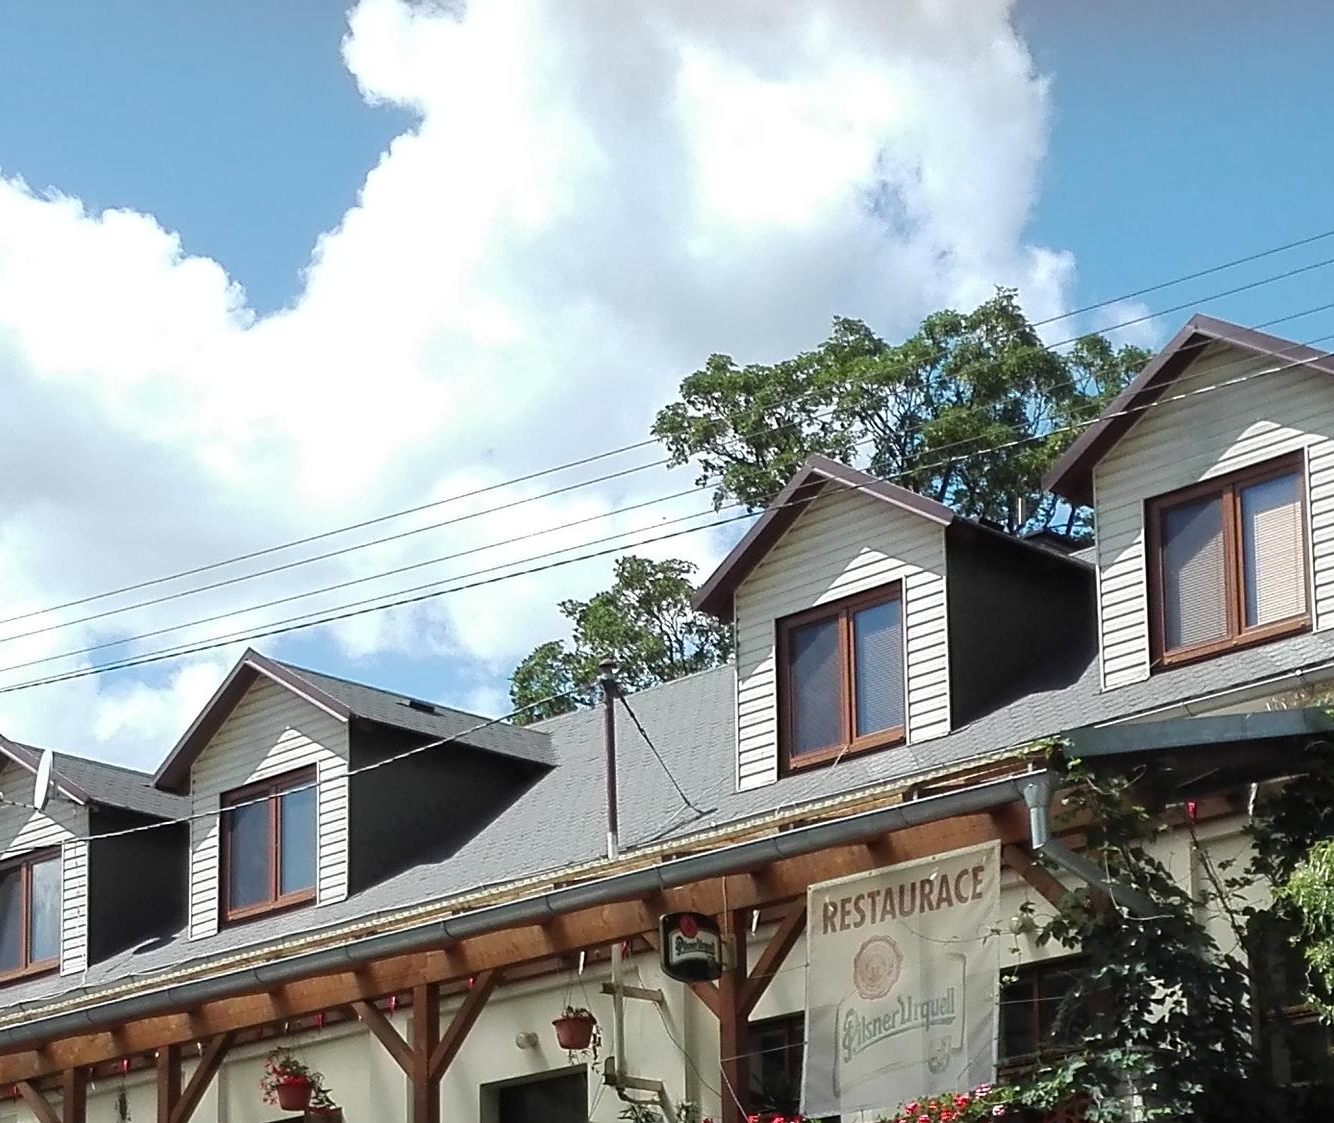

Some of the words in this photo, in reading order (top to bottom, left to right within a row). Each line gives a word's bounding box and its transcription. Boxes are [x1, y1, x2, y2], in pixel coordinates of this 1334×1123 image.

[822, 866, 985, 935] RESTAURACE
[843, 1008, 899, 1063] Pilsner
[897, 988, 955, 1032] Urquell
